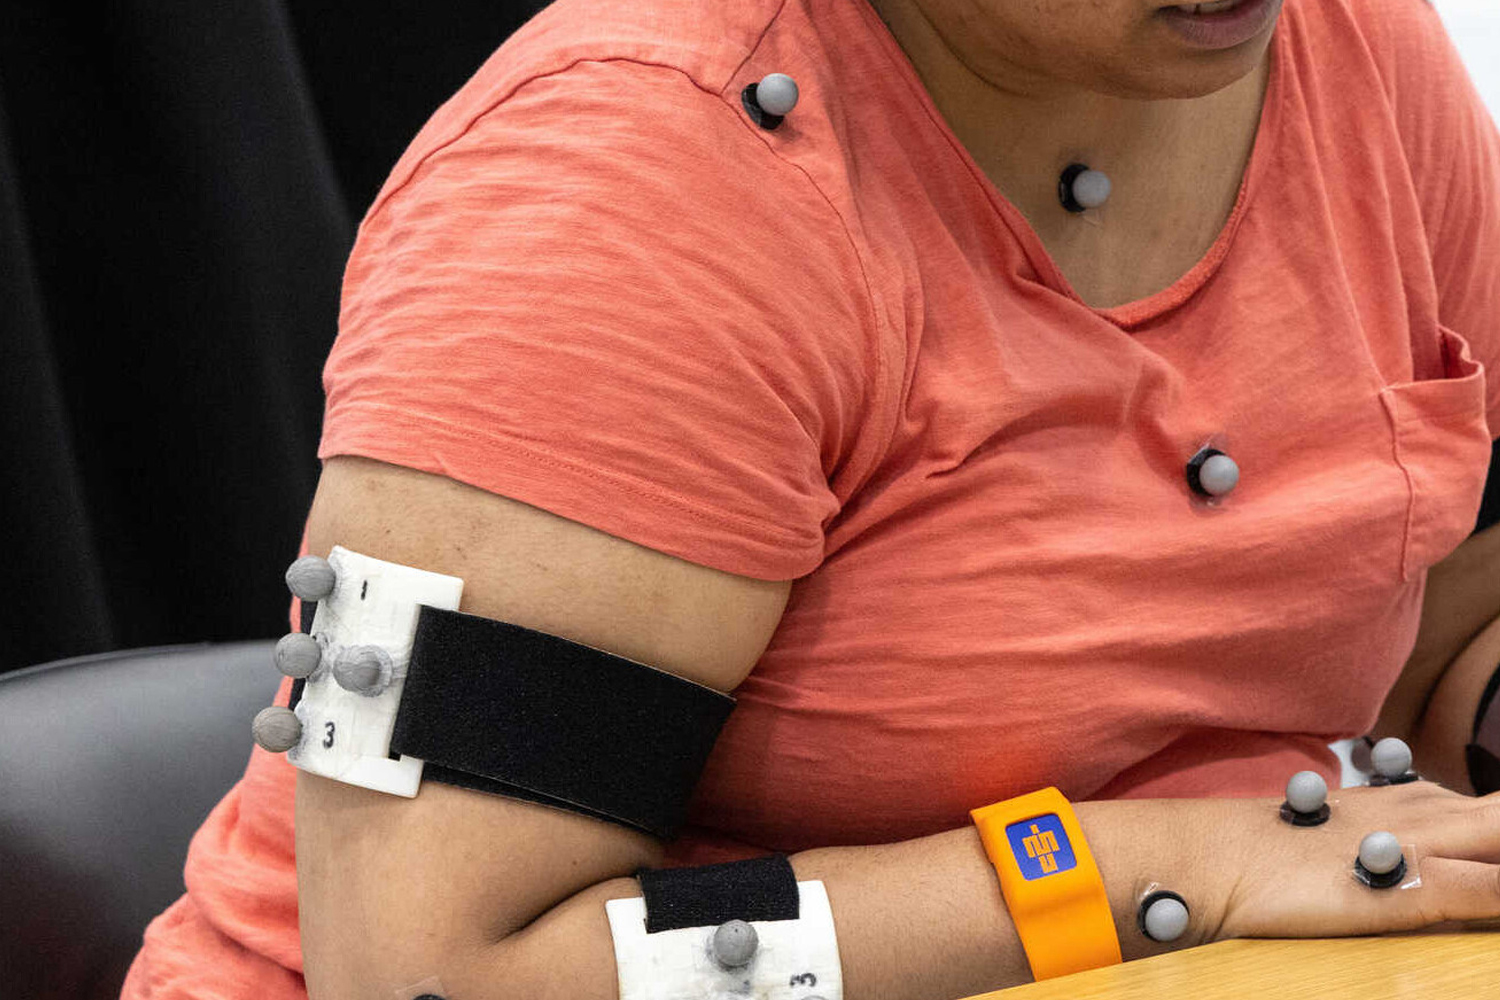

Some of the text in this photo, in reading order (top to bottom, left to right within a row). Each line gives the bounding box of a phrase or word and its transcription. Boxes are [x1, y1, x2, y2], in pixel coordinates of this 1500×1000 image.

[360, 579, 368, 601] 1
[323, 720, 336, 749] 3
[789, 972, 817, 988] 3
